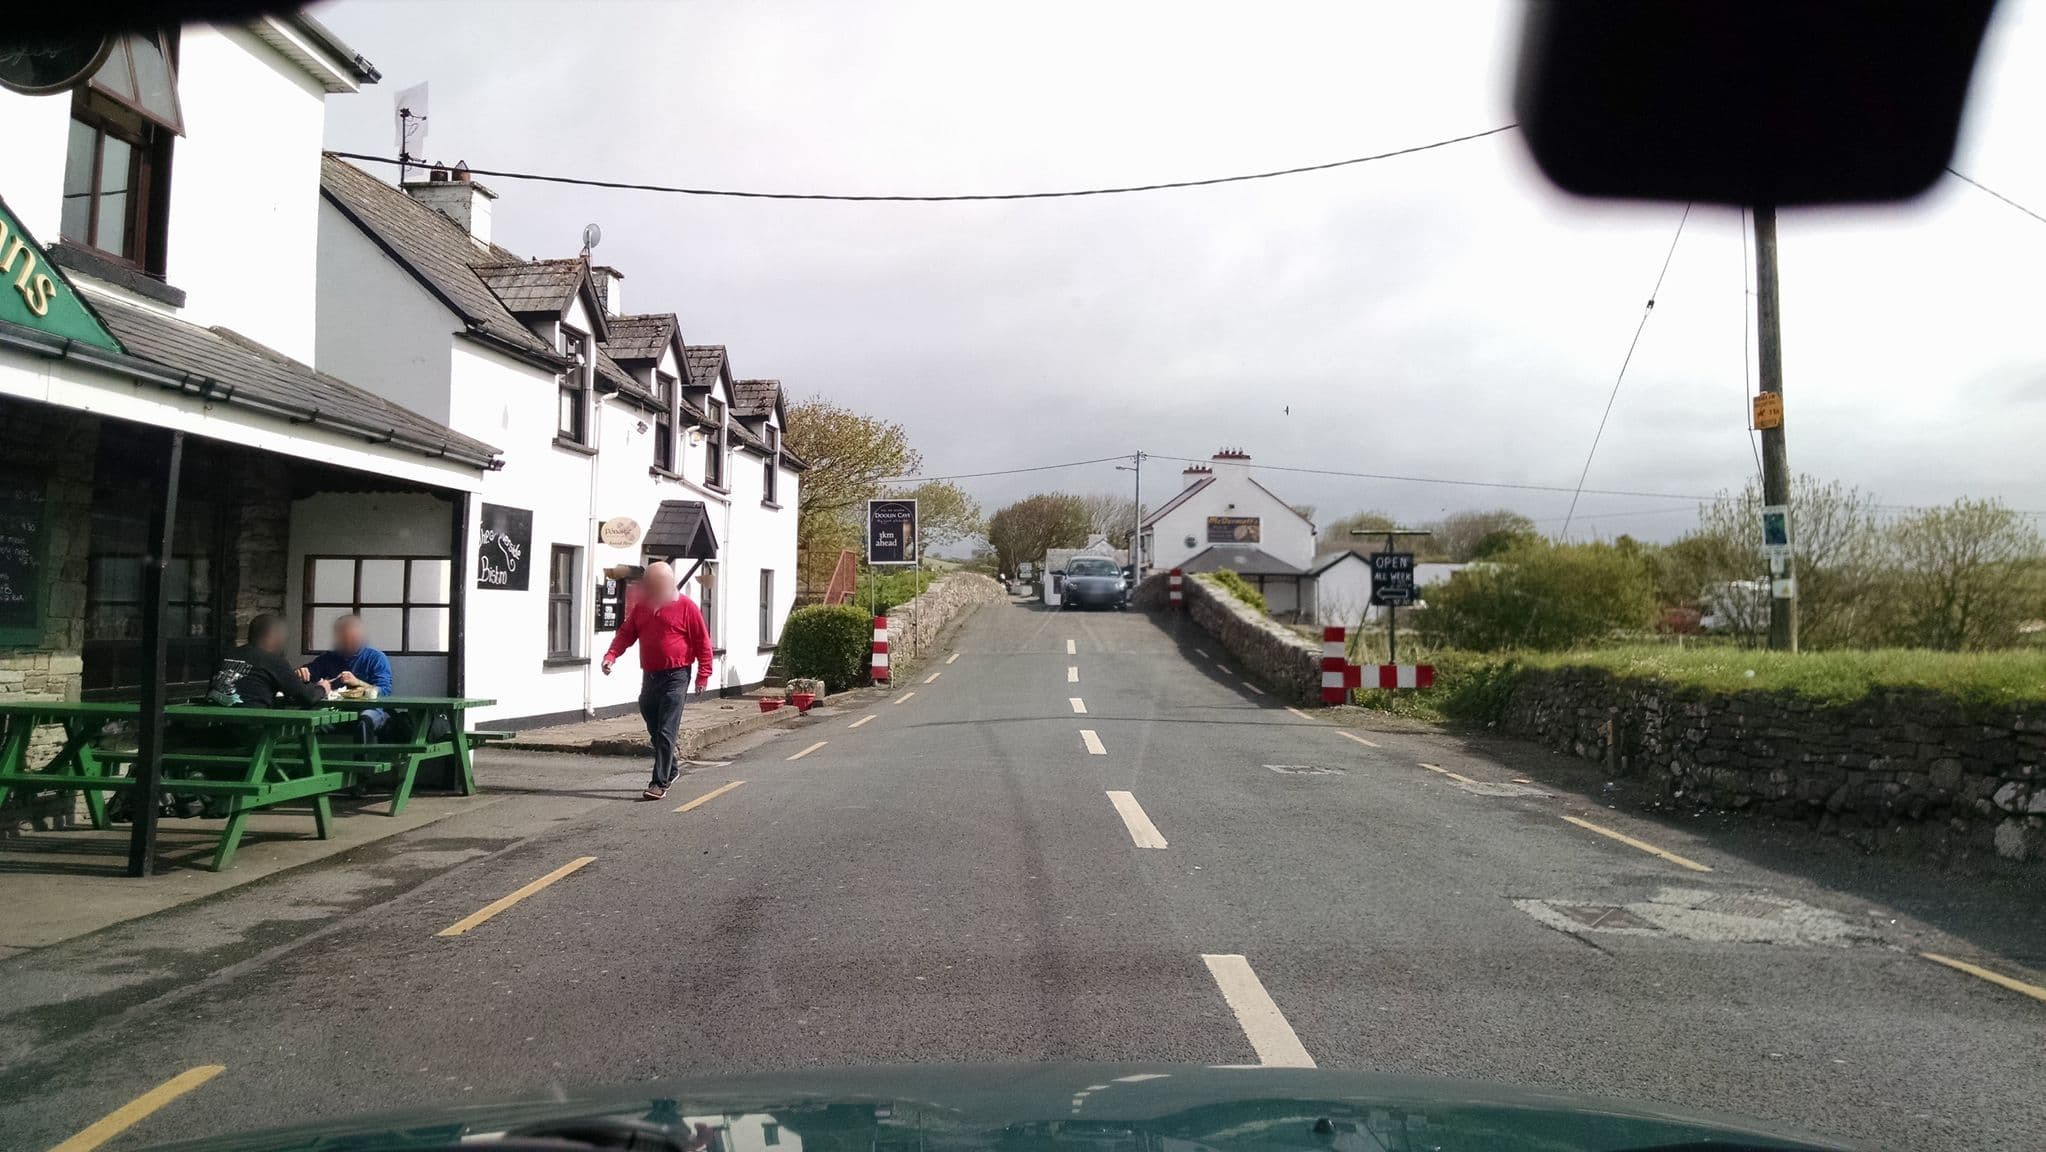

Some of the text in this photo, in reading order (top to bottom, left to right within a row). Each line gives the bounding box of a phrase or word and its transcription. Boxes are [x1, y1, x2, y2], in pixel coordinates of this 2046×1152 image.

[875, 539, 897, 547] ahead
[1375, 557, 1408, 568] OPEN
[478, 555, 507, 585] Bistro
